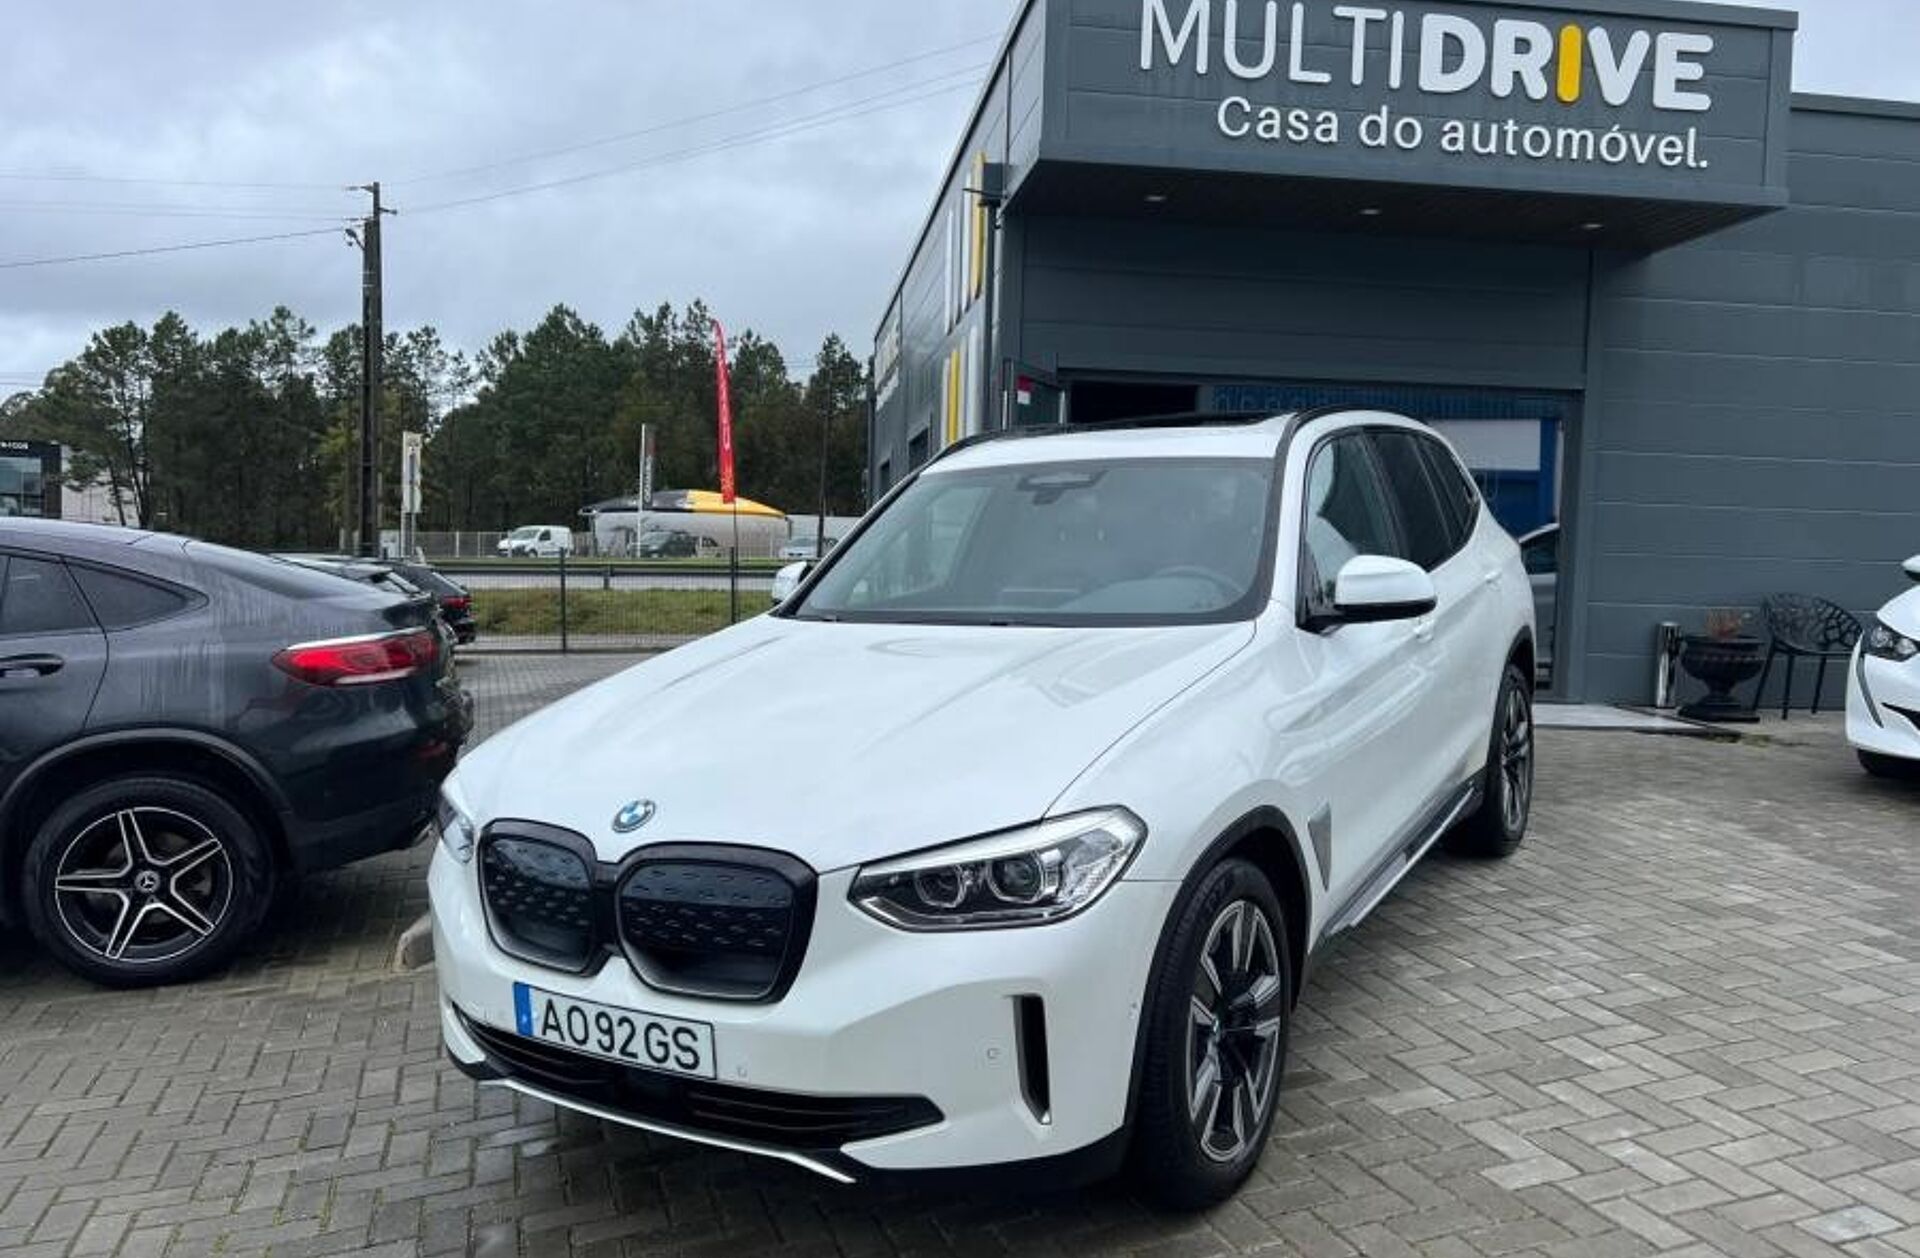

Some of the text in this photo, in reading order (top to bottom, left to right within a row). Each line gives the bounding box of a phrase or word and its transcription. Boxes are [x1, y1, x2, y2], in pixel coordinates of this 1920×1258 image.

[1217, 96, 1709, 169] Casa do automóvel.
